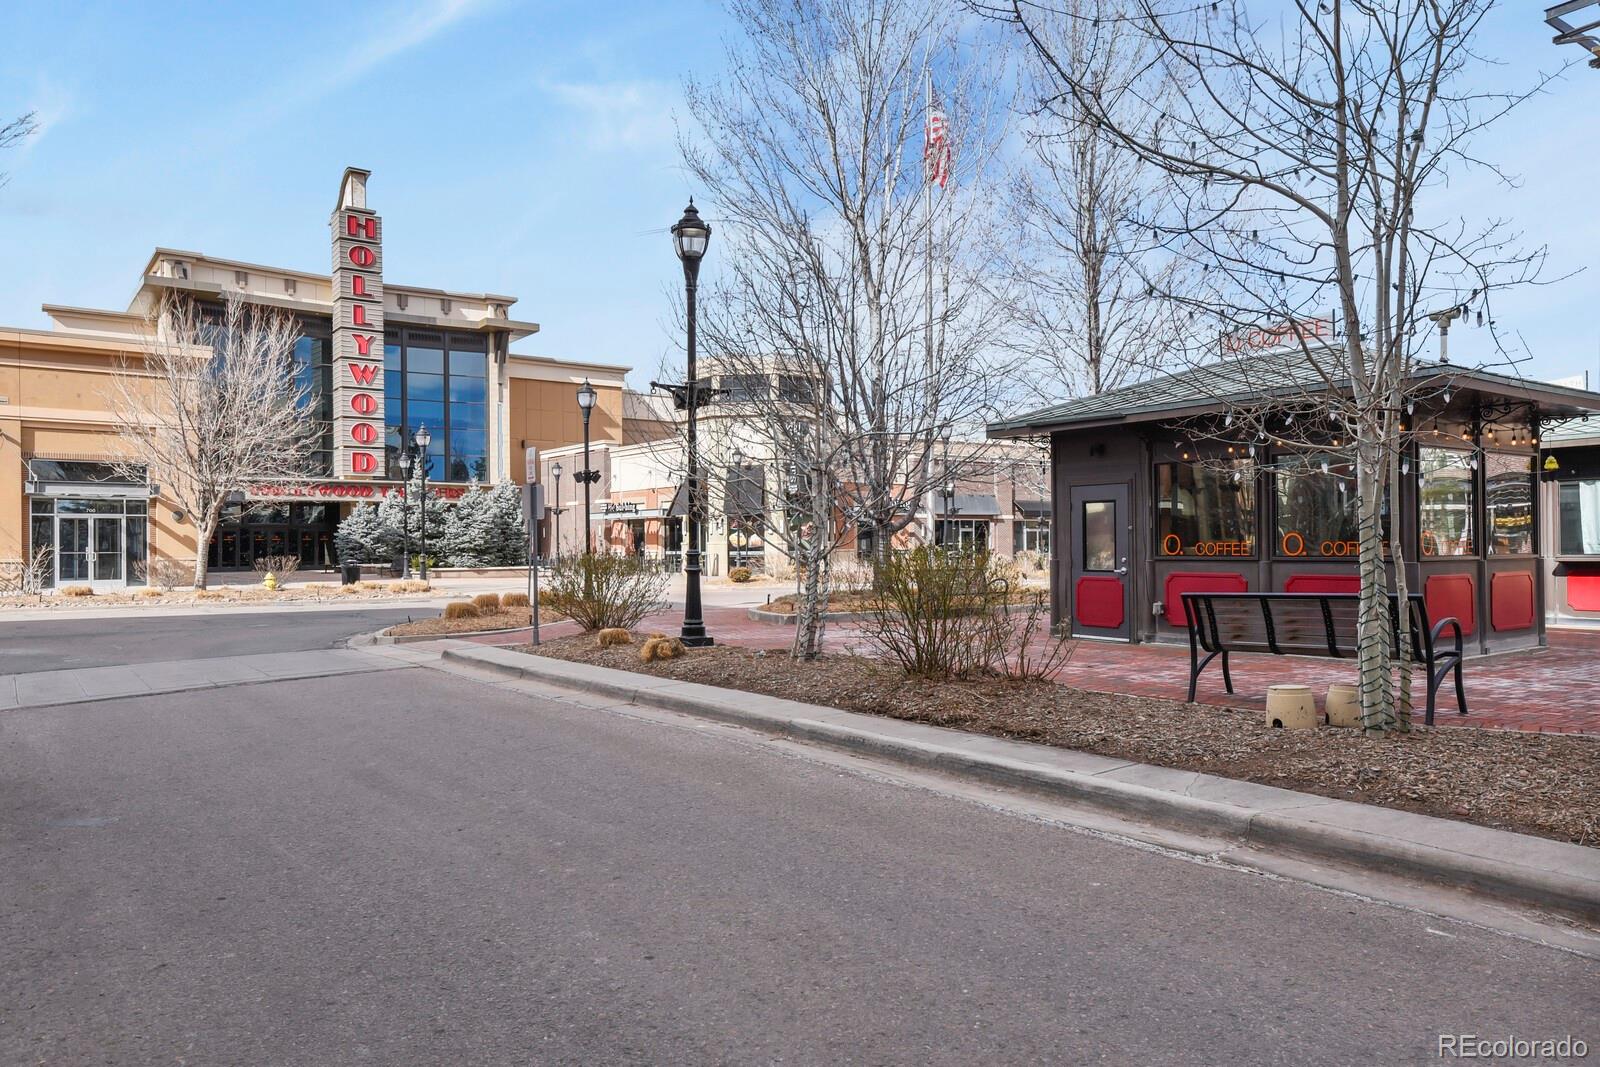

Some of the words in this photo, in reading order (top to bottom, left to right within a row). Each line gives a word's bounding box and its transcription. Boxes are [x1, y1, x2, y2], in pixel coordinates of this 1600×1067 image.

[346, 214, 378, 473] HOLLYWOOD
[1195, 542, 1250, 556] COFFEE
[1321, 541, 1389, 556] COFE
